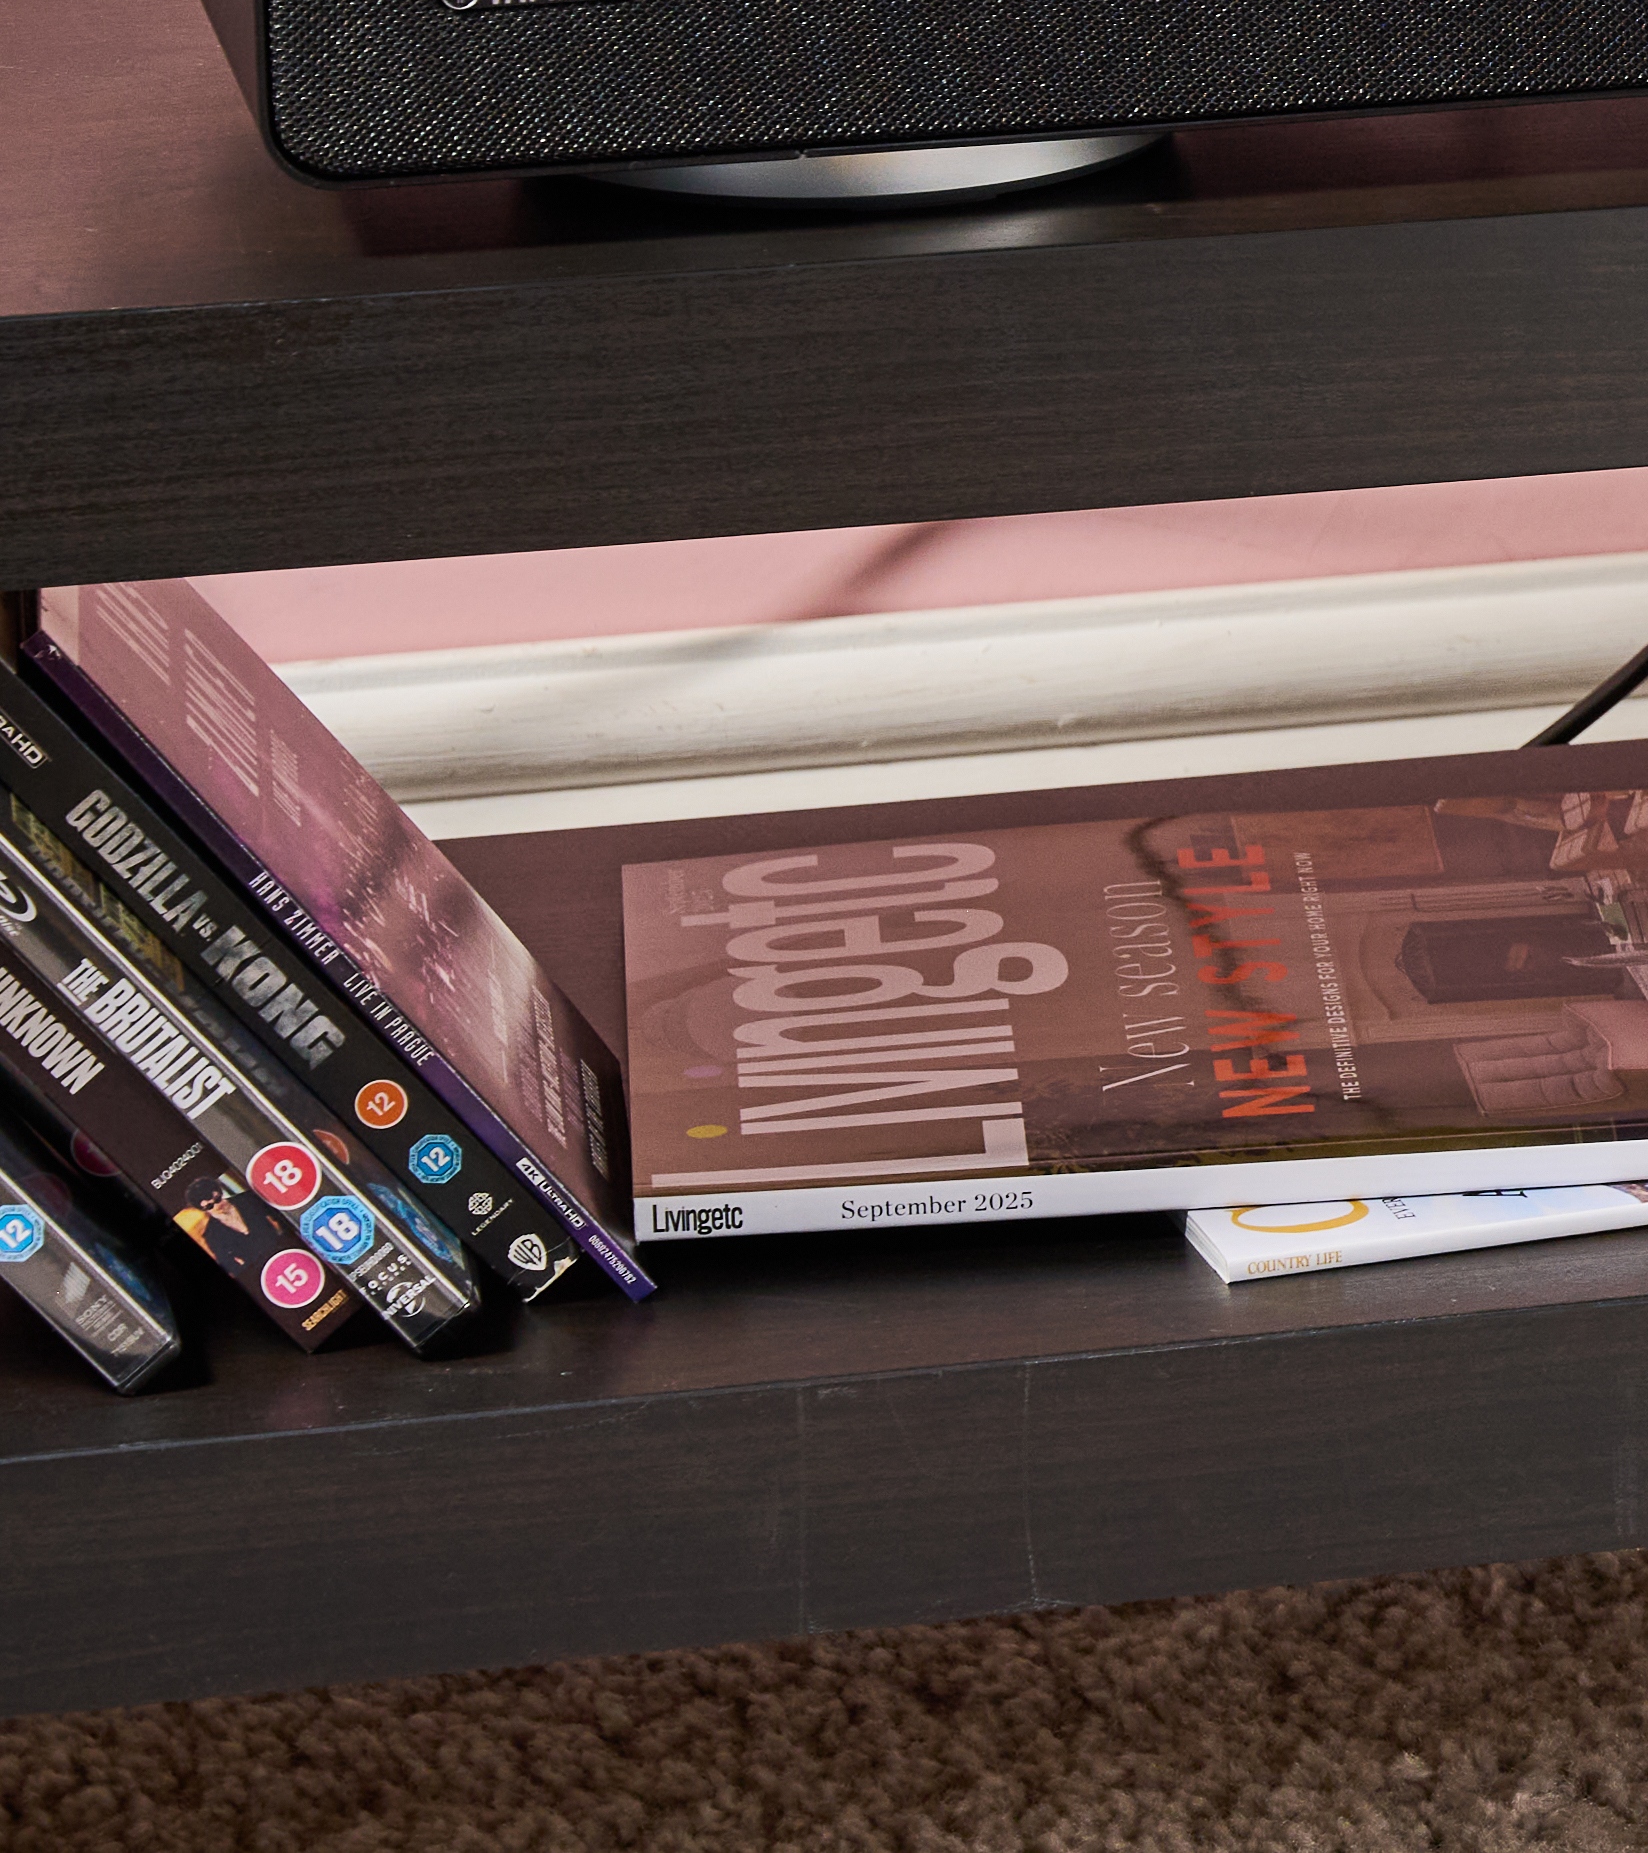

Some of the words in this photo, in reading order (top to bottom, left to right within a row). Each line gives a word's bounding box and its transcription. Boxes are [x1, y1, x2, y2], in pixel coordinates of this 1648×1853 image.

[65, 789, 207, 933] GODZILLA
[1293, 851, 1314, 874] NOW
[1298, 875, 1320, 904] RIGHT
[192, 913, 219, 942] VS.
[1176, 842, 1288, 984] STYLE
[1305, 904, 1327, 932] HOME
[1105, 879, 1181, 1001] season
[1311, 932, 1334, 960] YOUR
[61, 958, 110, 1002] THE
[249, 870, 290, 912] HANS
[284, 910, 340, 966] ZIMMER
[343, 972, 378, 1006] LIVE
[370, 1002, 393, 1021] IN
[384, 1016, 435, 1067] PRAGUE
[1317, 961, 1336, 981] FOR
[200, 924, 346, 1070] KONG
[1320, 980, 1346, 1025] DESIGNS
[650, 842, 1070, 1189] Livingetc
[84, 977, 237, 1120] BRUTALIST
[1101, 1012, 1197, 1094] New
[1206, 1004, 1316, 1120] NEW
[1330, 1025, 1359, 1079] DEFINITIVE
[366, 1091, 396, 1116] 12
[1343, 1079, 1362, 1101] THE
[263, 1158, 303, 1194] 18
[420, 1146, 451, 1172] 12
[521, 1162, 539, 1180] 4K
[471, 1198, 514, 1236] LEGENDARY
[651, 1203, 743, 1237] Livingetc
[840, 1193, 967, 1223] September
[972, 1189, 1034, 1213] 2025
[0, 1218, 31, 1249] 12
[316, 1212, 360, 1250] 18
[276, 1263, 309, 1295] 15
[1247, 1254, 1312, 1275] COUNTRY
[1316, 1251, 1343, 1266] LIFE
[75, 1294, 107, 1326] SONY
[301, 1288, 348, 1332] SEARCHLIGHT
